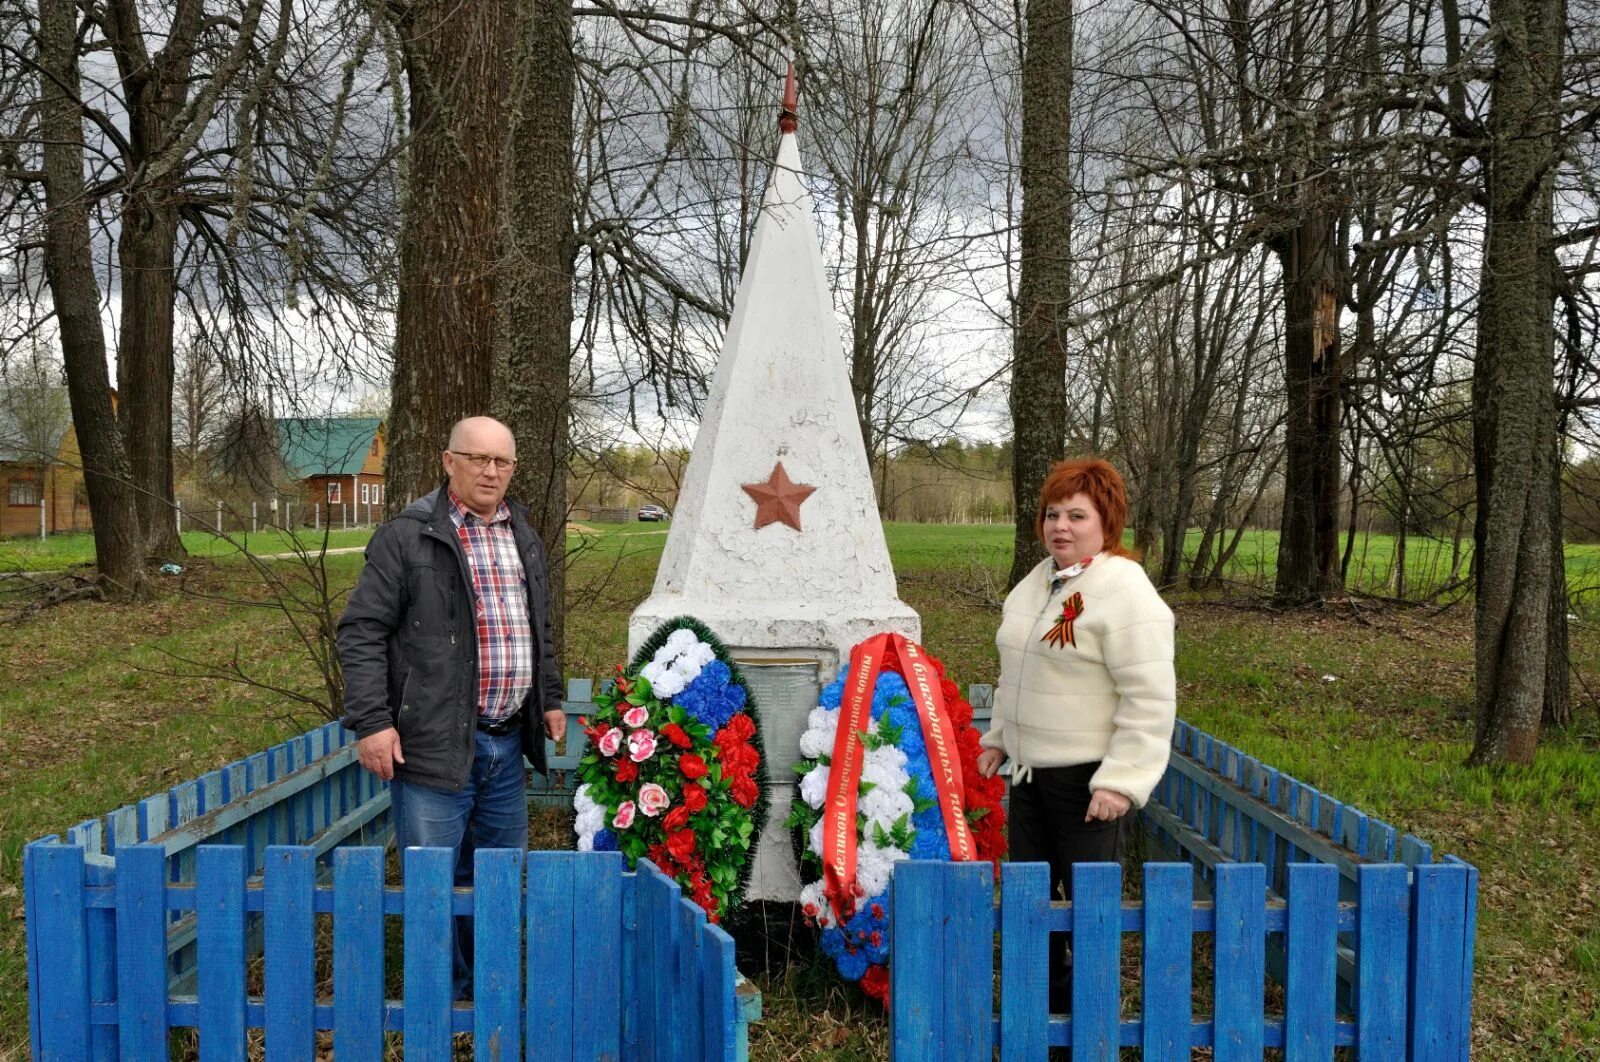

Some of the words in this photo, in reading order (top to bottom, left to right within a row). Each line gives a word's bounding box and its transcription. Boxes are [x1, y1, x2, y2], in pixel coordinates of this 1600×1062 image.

[857, 655, 872, 693] войны
[835, 695, 863, 807] Отечественной
[912, 662, 955, 787] благодарных
[833, 812, 847, 877] Великой
